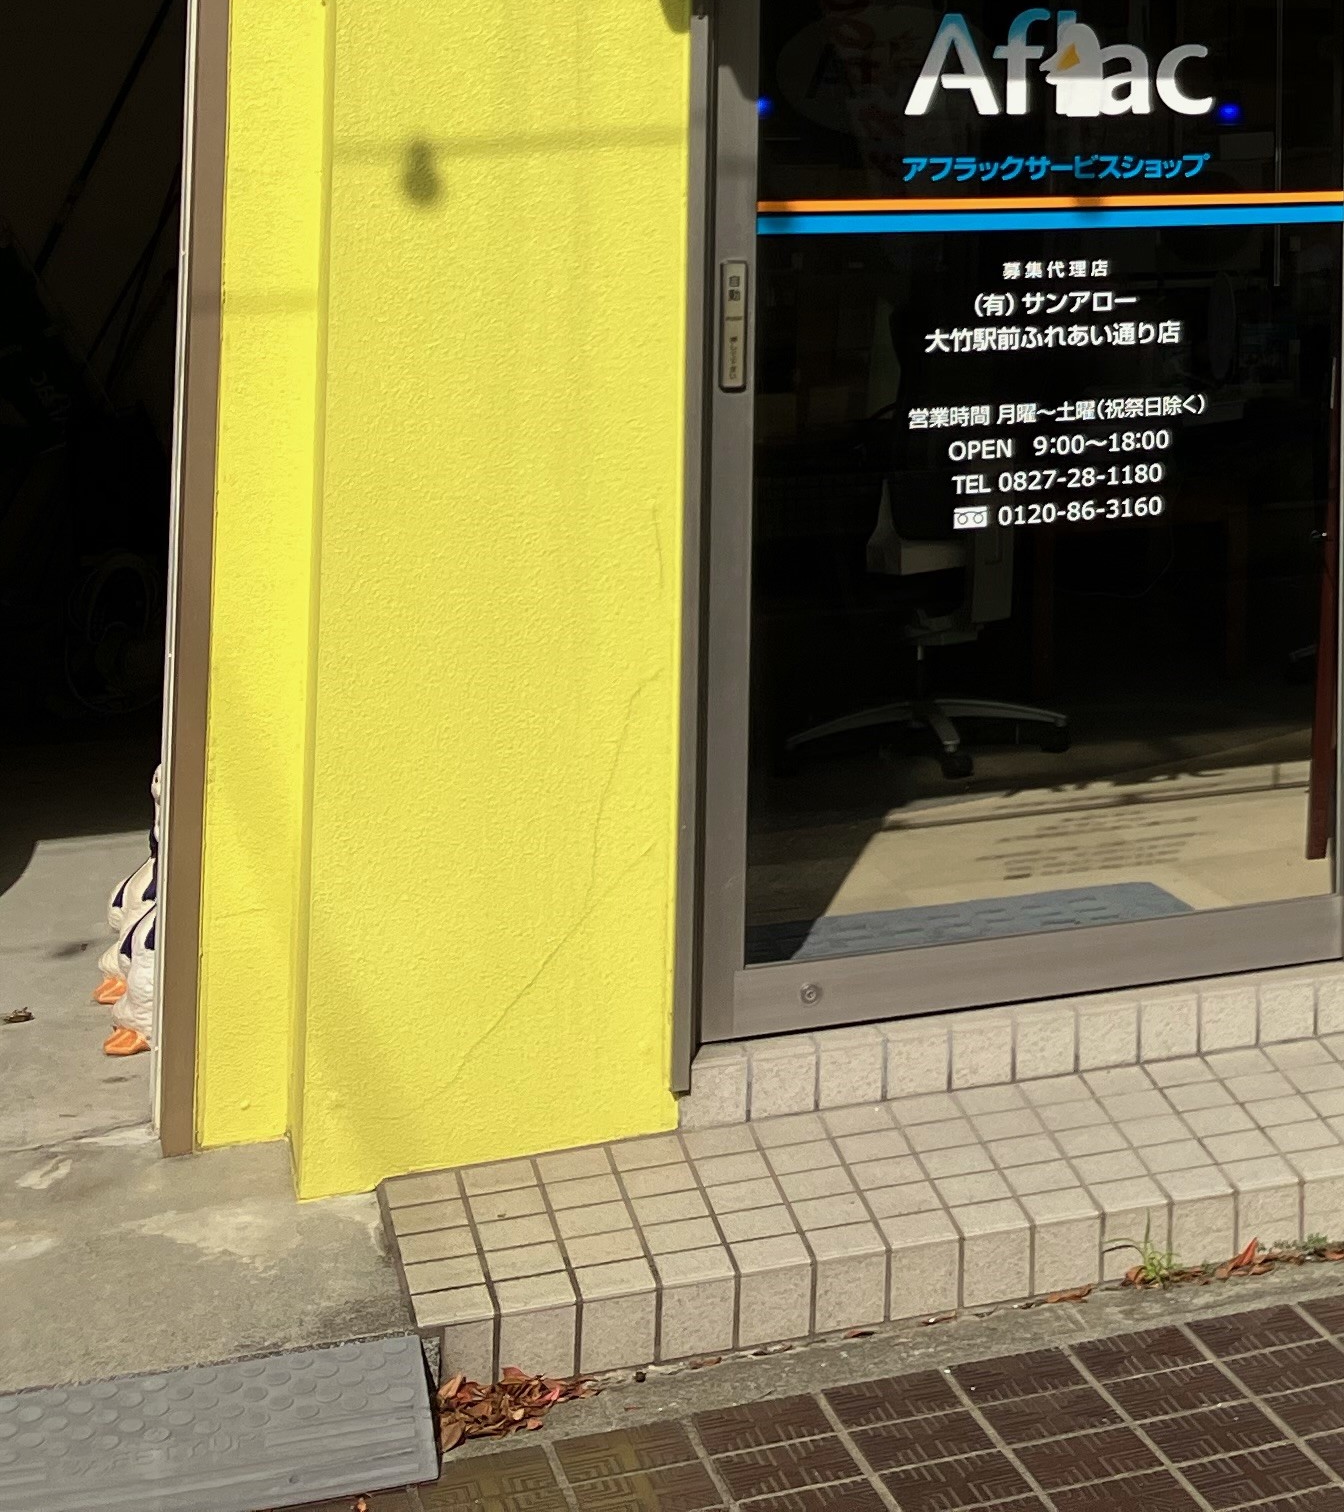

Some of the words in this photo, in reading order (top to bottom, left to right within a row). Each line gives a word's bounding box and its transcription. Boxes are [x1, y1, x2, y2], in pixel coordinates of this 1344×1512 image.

[902, 152, 1211, 182] アフラックサービスショップ
[1002, 259, 1109, 280] 募集代理店
[925, 320, 1181, 354] 大竹駅前ふれあい通り店
[908, 405, 991, 430] 営業時間
[948, 439, 1013, 461] OPEN
[952, 474, 992, 495] TEL
[998, 463, 1163, 493] 0827-28-1180
[998, 496, 1163, 527] 0120-86-3160
